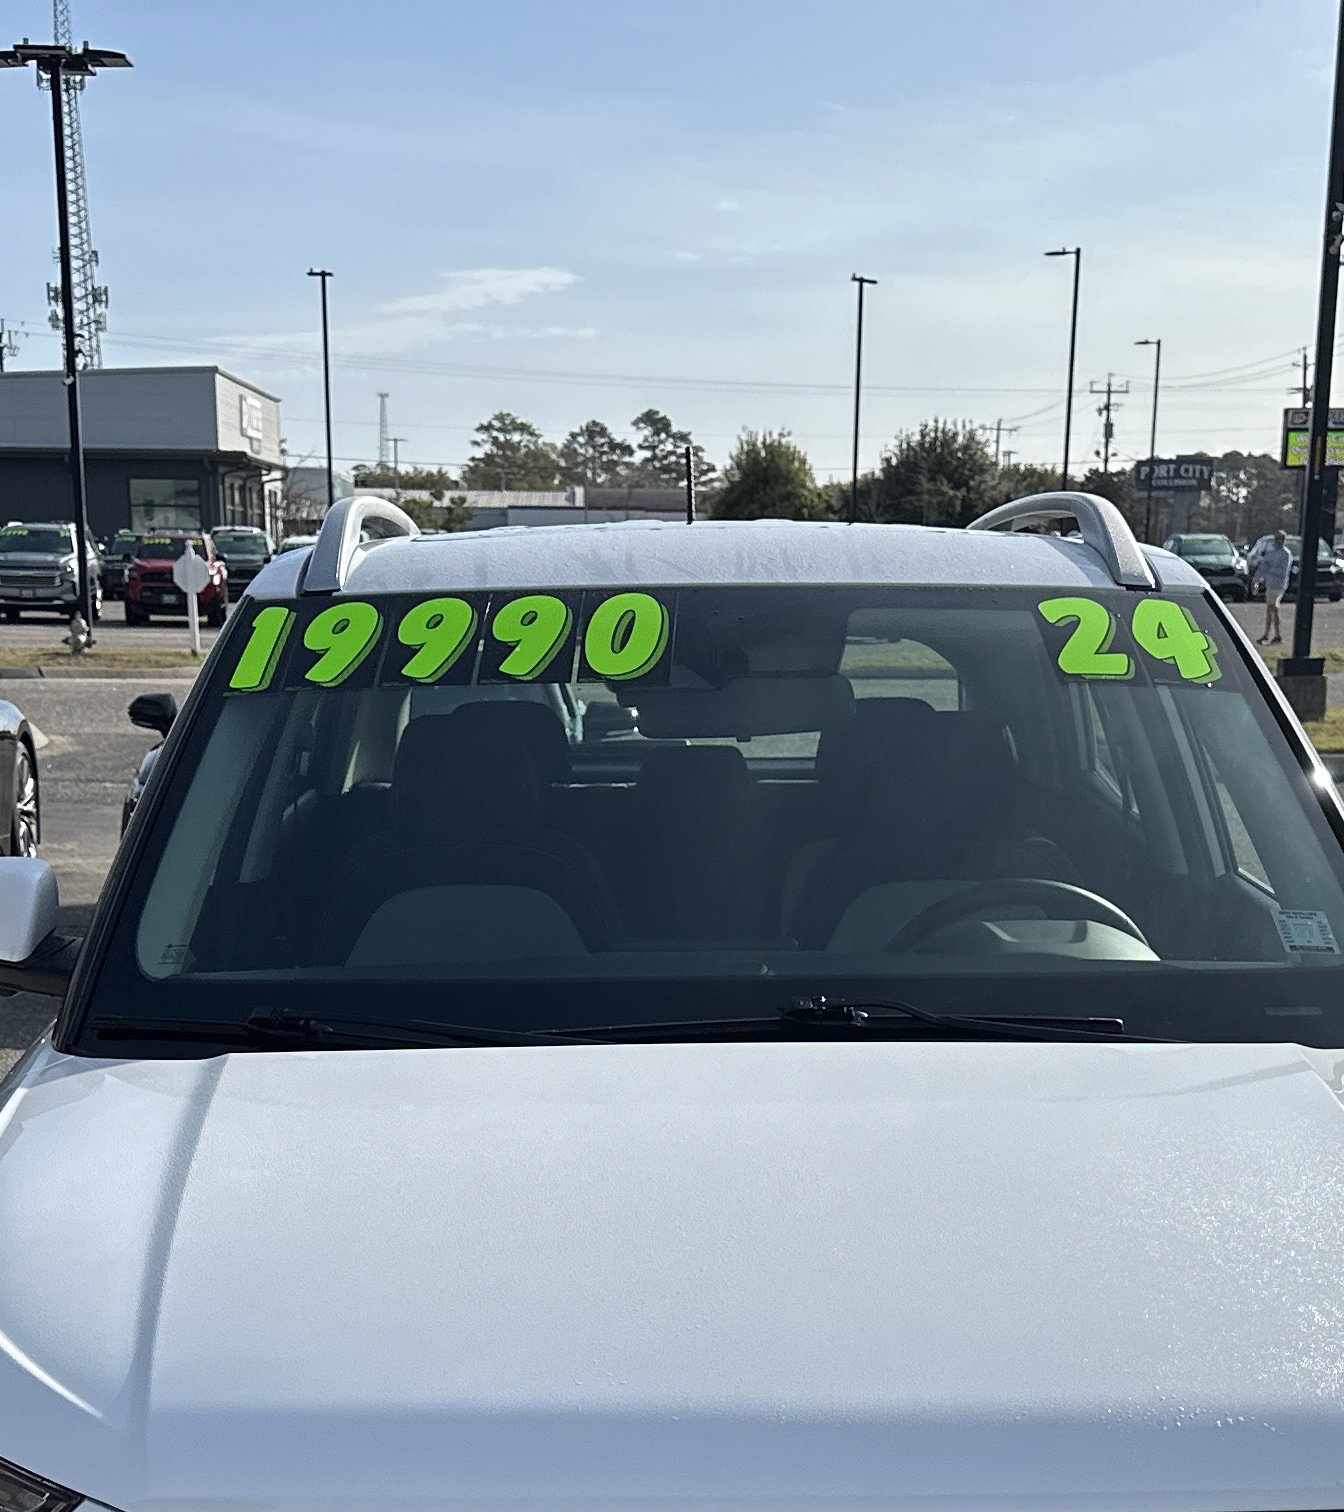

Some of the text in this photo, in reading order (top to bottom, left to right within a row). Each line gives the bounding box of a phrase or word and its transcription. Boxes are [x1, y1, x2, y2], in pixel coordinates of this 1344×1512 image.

[1180, 463, 1211, 479] CITY
[228, 592, 670, 692] 19990
[1037, 597, 1223, 684] 24
